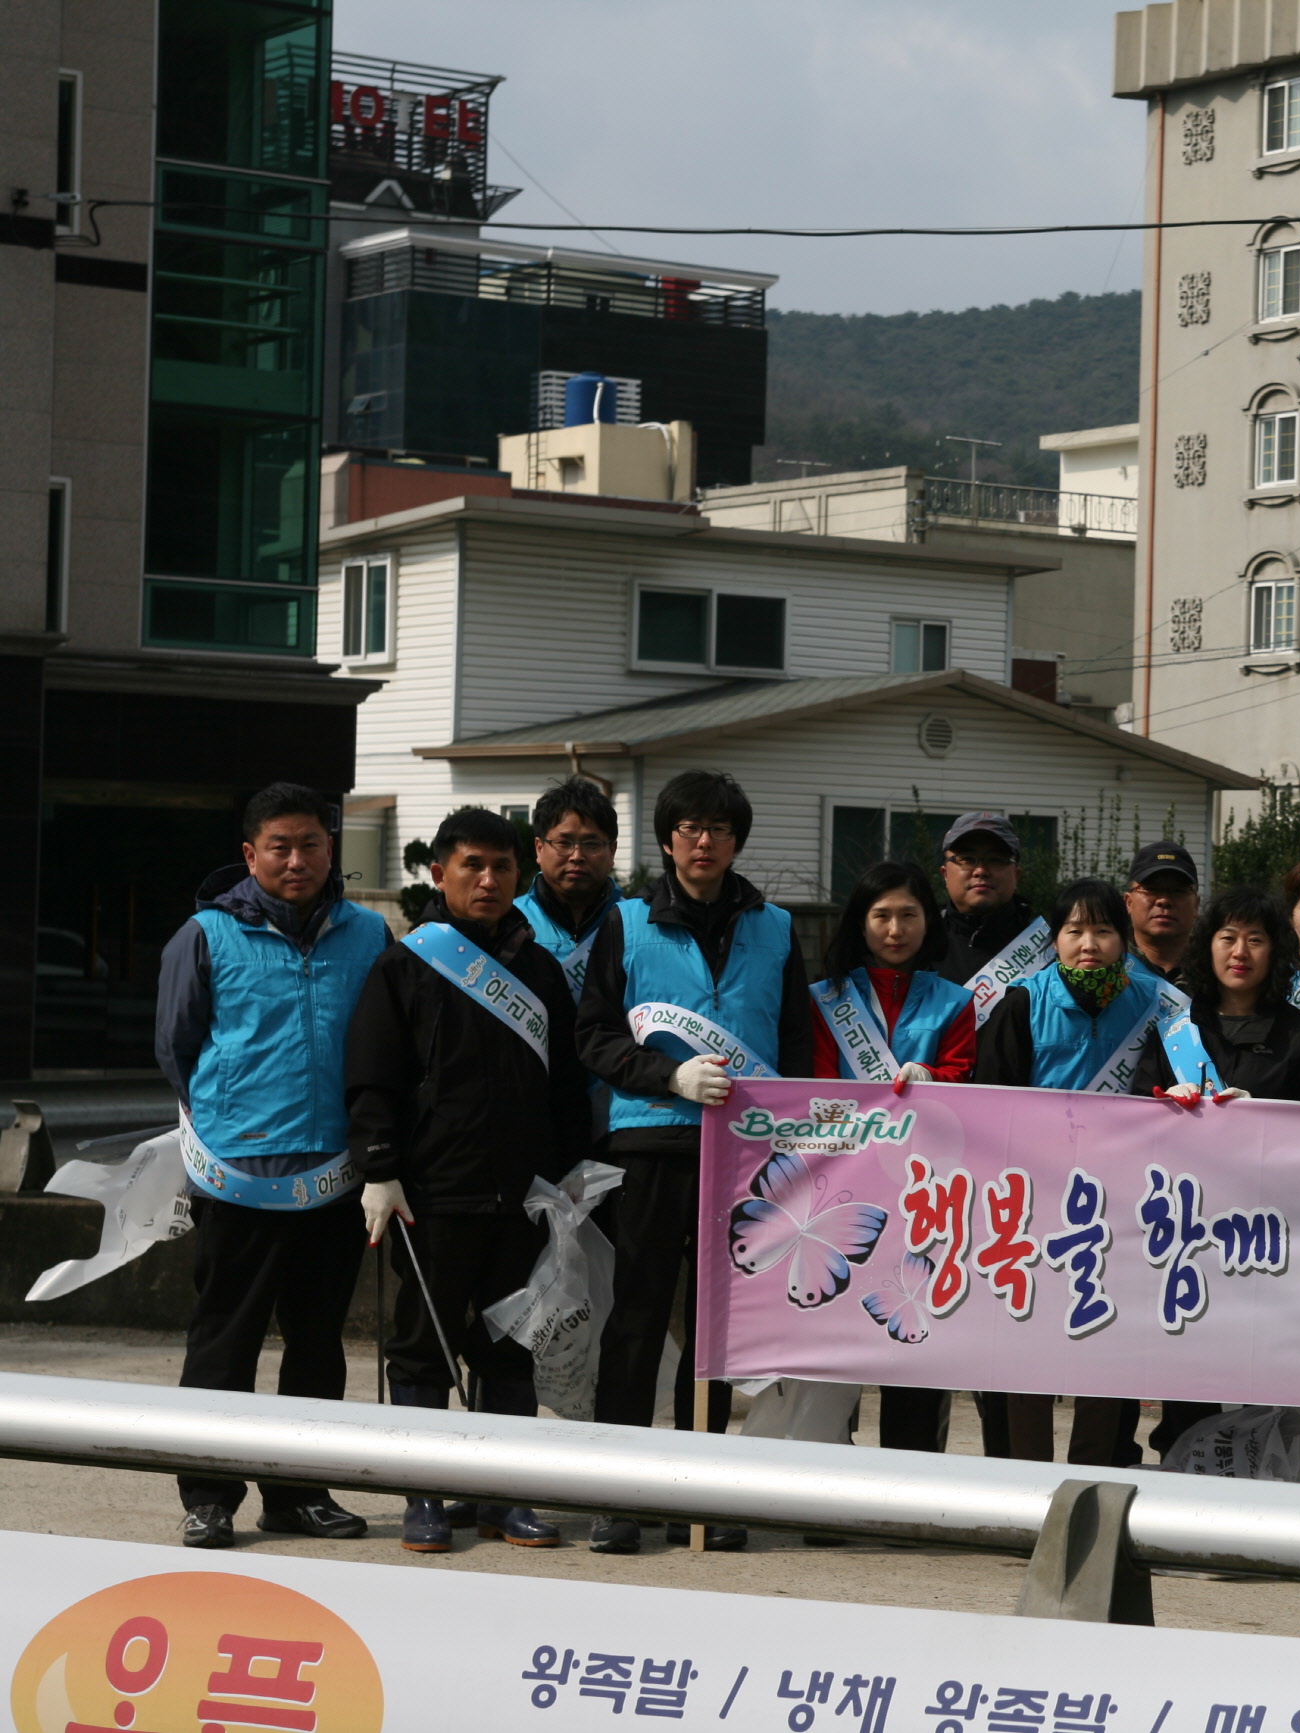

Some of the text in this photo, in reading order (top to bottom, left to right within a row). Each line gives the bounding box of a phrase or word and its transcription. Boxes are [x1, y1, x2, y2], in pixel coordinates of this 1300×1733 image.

[652, 1009, 747, 1070] 우리환경
[733, 1107, 910, 1146] Beautiful
[774, 1138, 856, 1153] GyeongJu
[904, 1158, 1108, 1332] 행복을
[1140, 1168, 1281, 1324] 함께
[522, 1645, 698, 1719] 왕족발
[777, 1670, 897, 1733] 냉채
[925, 1680, 1118, 1733] 왕족발
